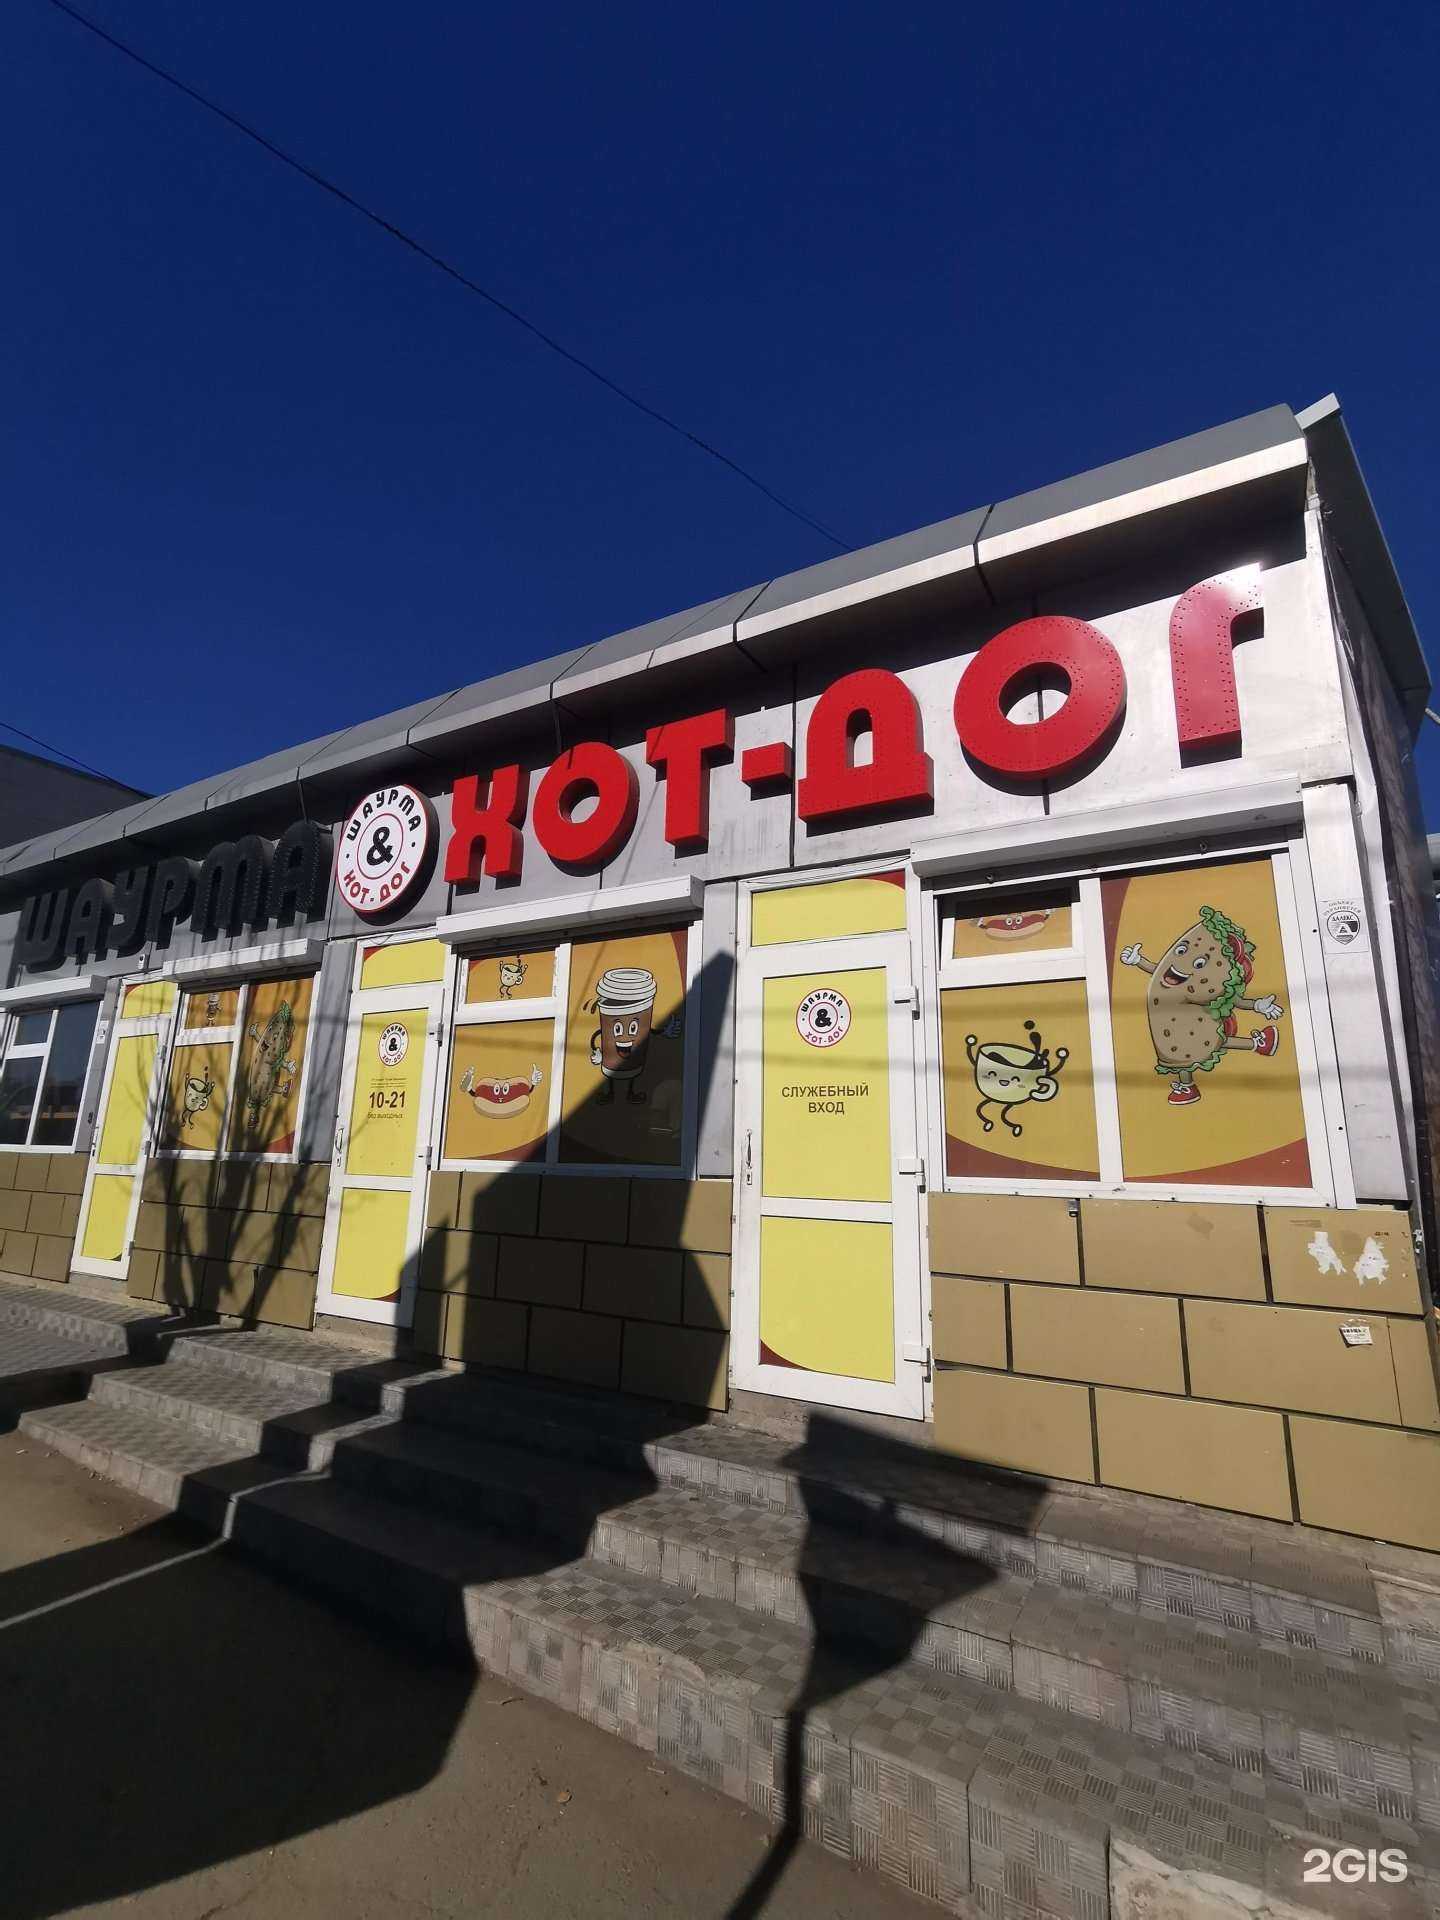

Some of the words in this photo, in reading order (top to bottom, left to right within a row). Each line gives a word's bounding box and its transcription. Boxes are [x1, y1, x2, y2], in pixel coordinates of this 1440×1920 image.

[444, 563, 1264, 886] ХОТ-ДОГ
[346, 788, 422, 842] ШАУРМА
[366, 826, 394, 866] &
[19, 818, 326, 968] ШАУРМА
[801, 991, 844, 1013] ШАУРМА
[814, 1008, 833, 1028] &
[369, 1090, 406, 1109] 10-21
[781, 1081, 869, 1098] СЛУЖЕБНЫЙ
[808, 1101, 846, 1116] ВХОД
